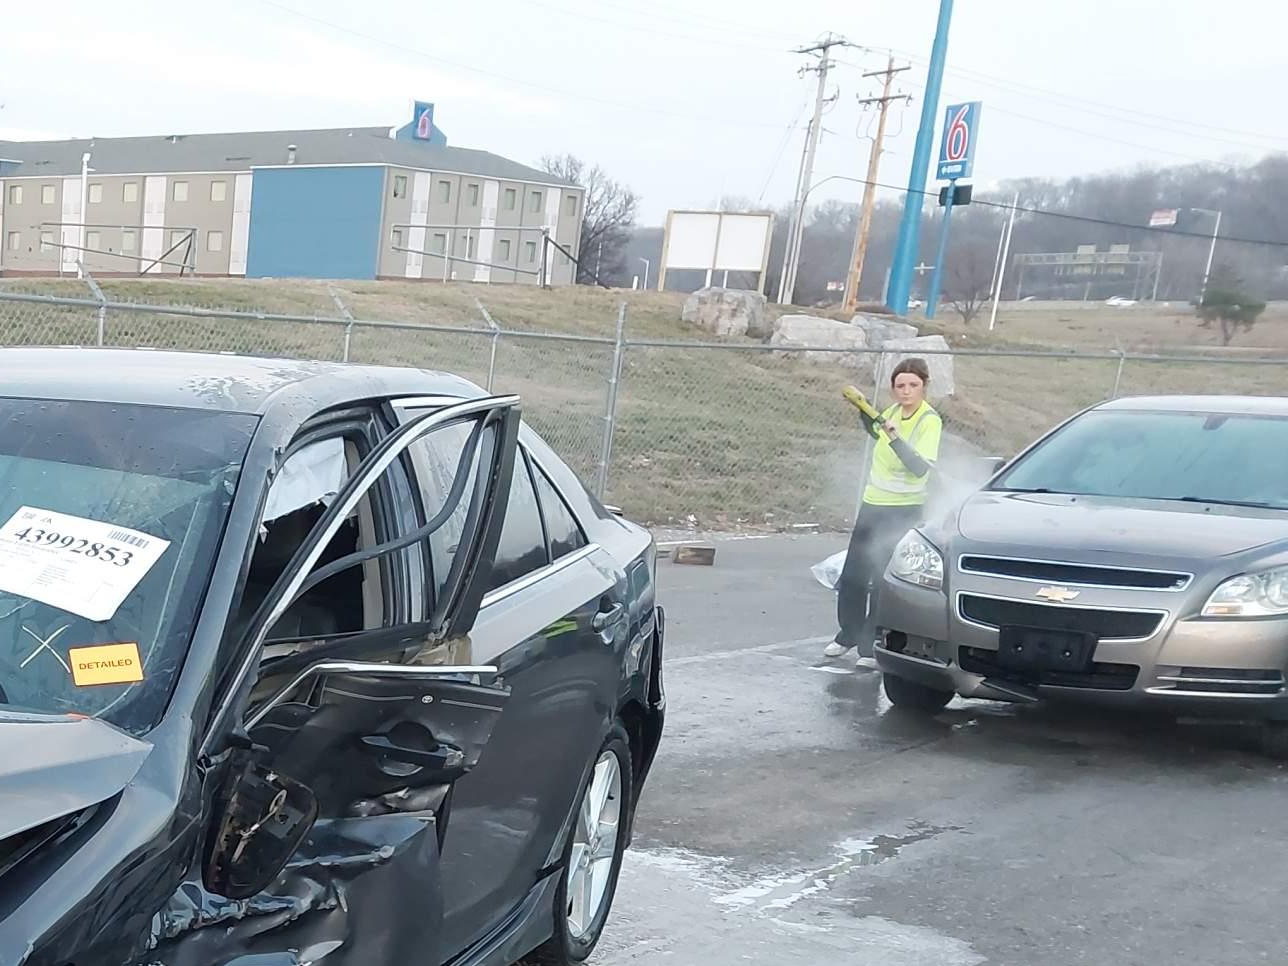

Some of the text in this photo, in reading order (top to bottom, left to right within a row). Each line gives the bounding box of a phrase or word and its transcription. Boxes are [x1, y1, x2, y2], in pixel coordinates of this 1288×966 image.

[946, 104, 969, 161] 6
[14, 527, 133, 567] 43992853
[78, 658, 133, 670] DETAILED
